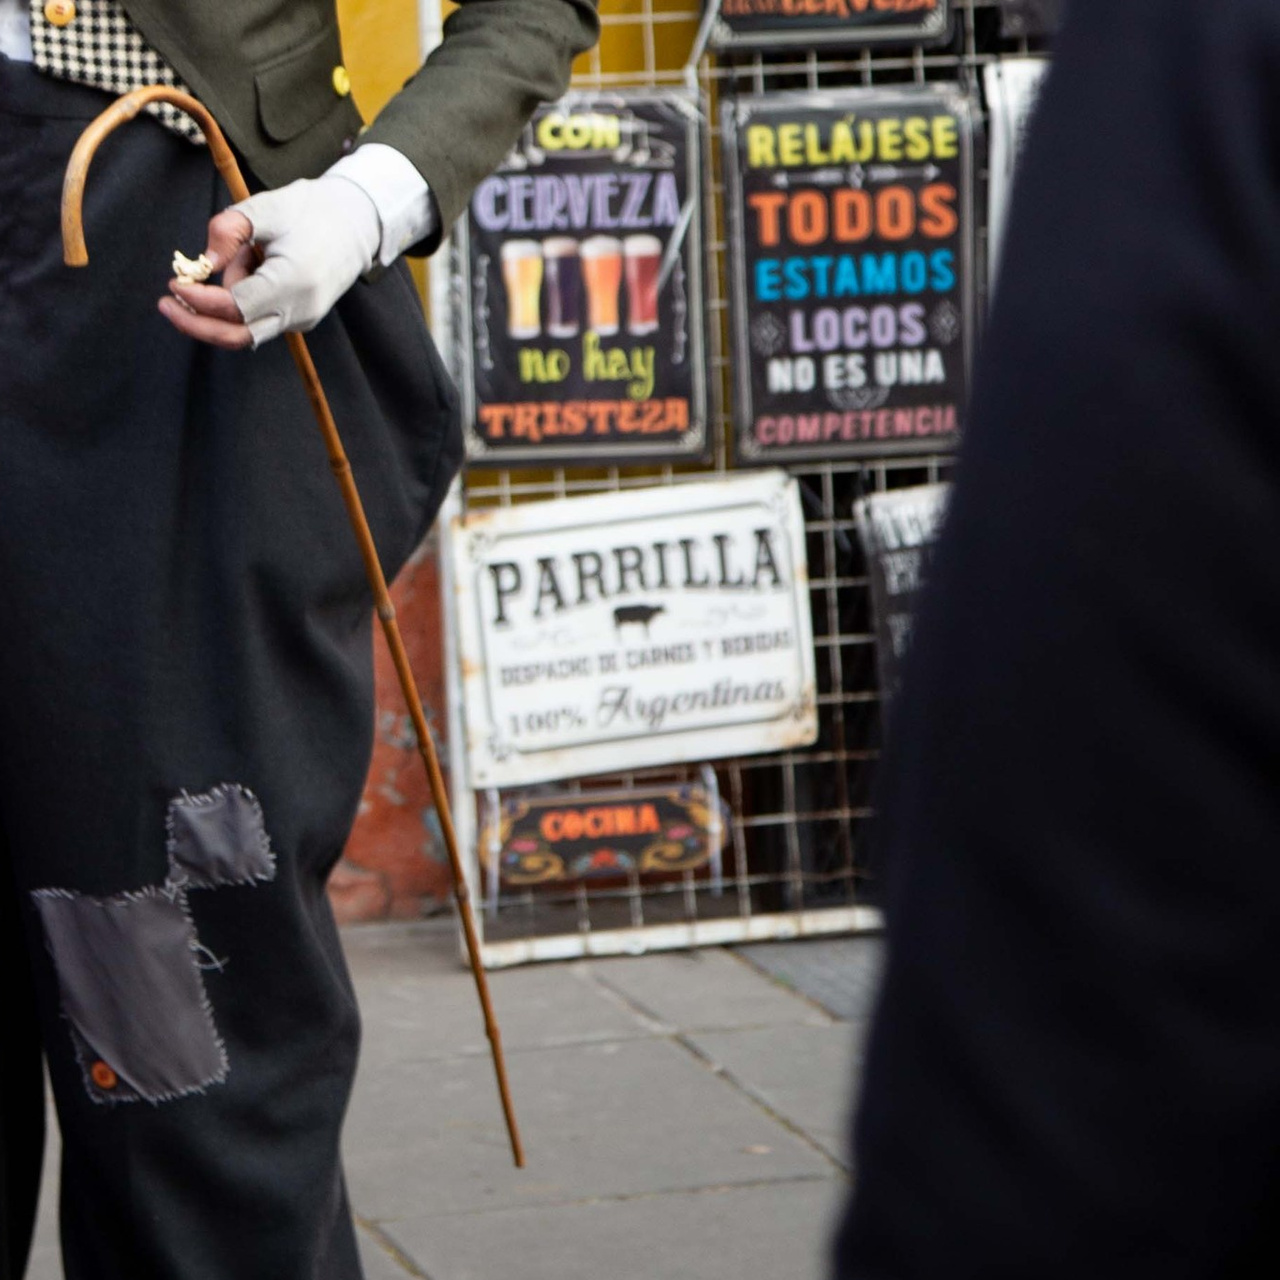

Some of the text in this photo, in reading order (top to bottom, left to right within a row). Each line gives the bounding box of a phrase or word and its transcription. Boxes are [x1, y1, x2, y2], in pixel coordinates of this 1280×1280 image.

[537, 114, 620, 150] CON
[747, 113, 958, 168] RELÁJESE
[472, 173, 681, 233] CERVEZA
[747, 182, 959, 249] TODOS
[754, 248, 957, 302] ESTAMOS
[790, 302, 926, 354] LOCOS
[518, 329, 656, 401] no hay
[767, 349, 946, 394] NO ES UNA
[479, 397, 690, 443] TRISTEZA
[488, 527, 782, 626] PARRILLA
[500, 629, 793, 688] DESPACHO DE CARNES Y BEBIDAS
[508, 676, 787, 737] 100% Argentinas
[539, 802, 661, 842] COCINA
